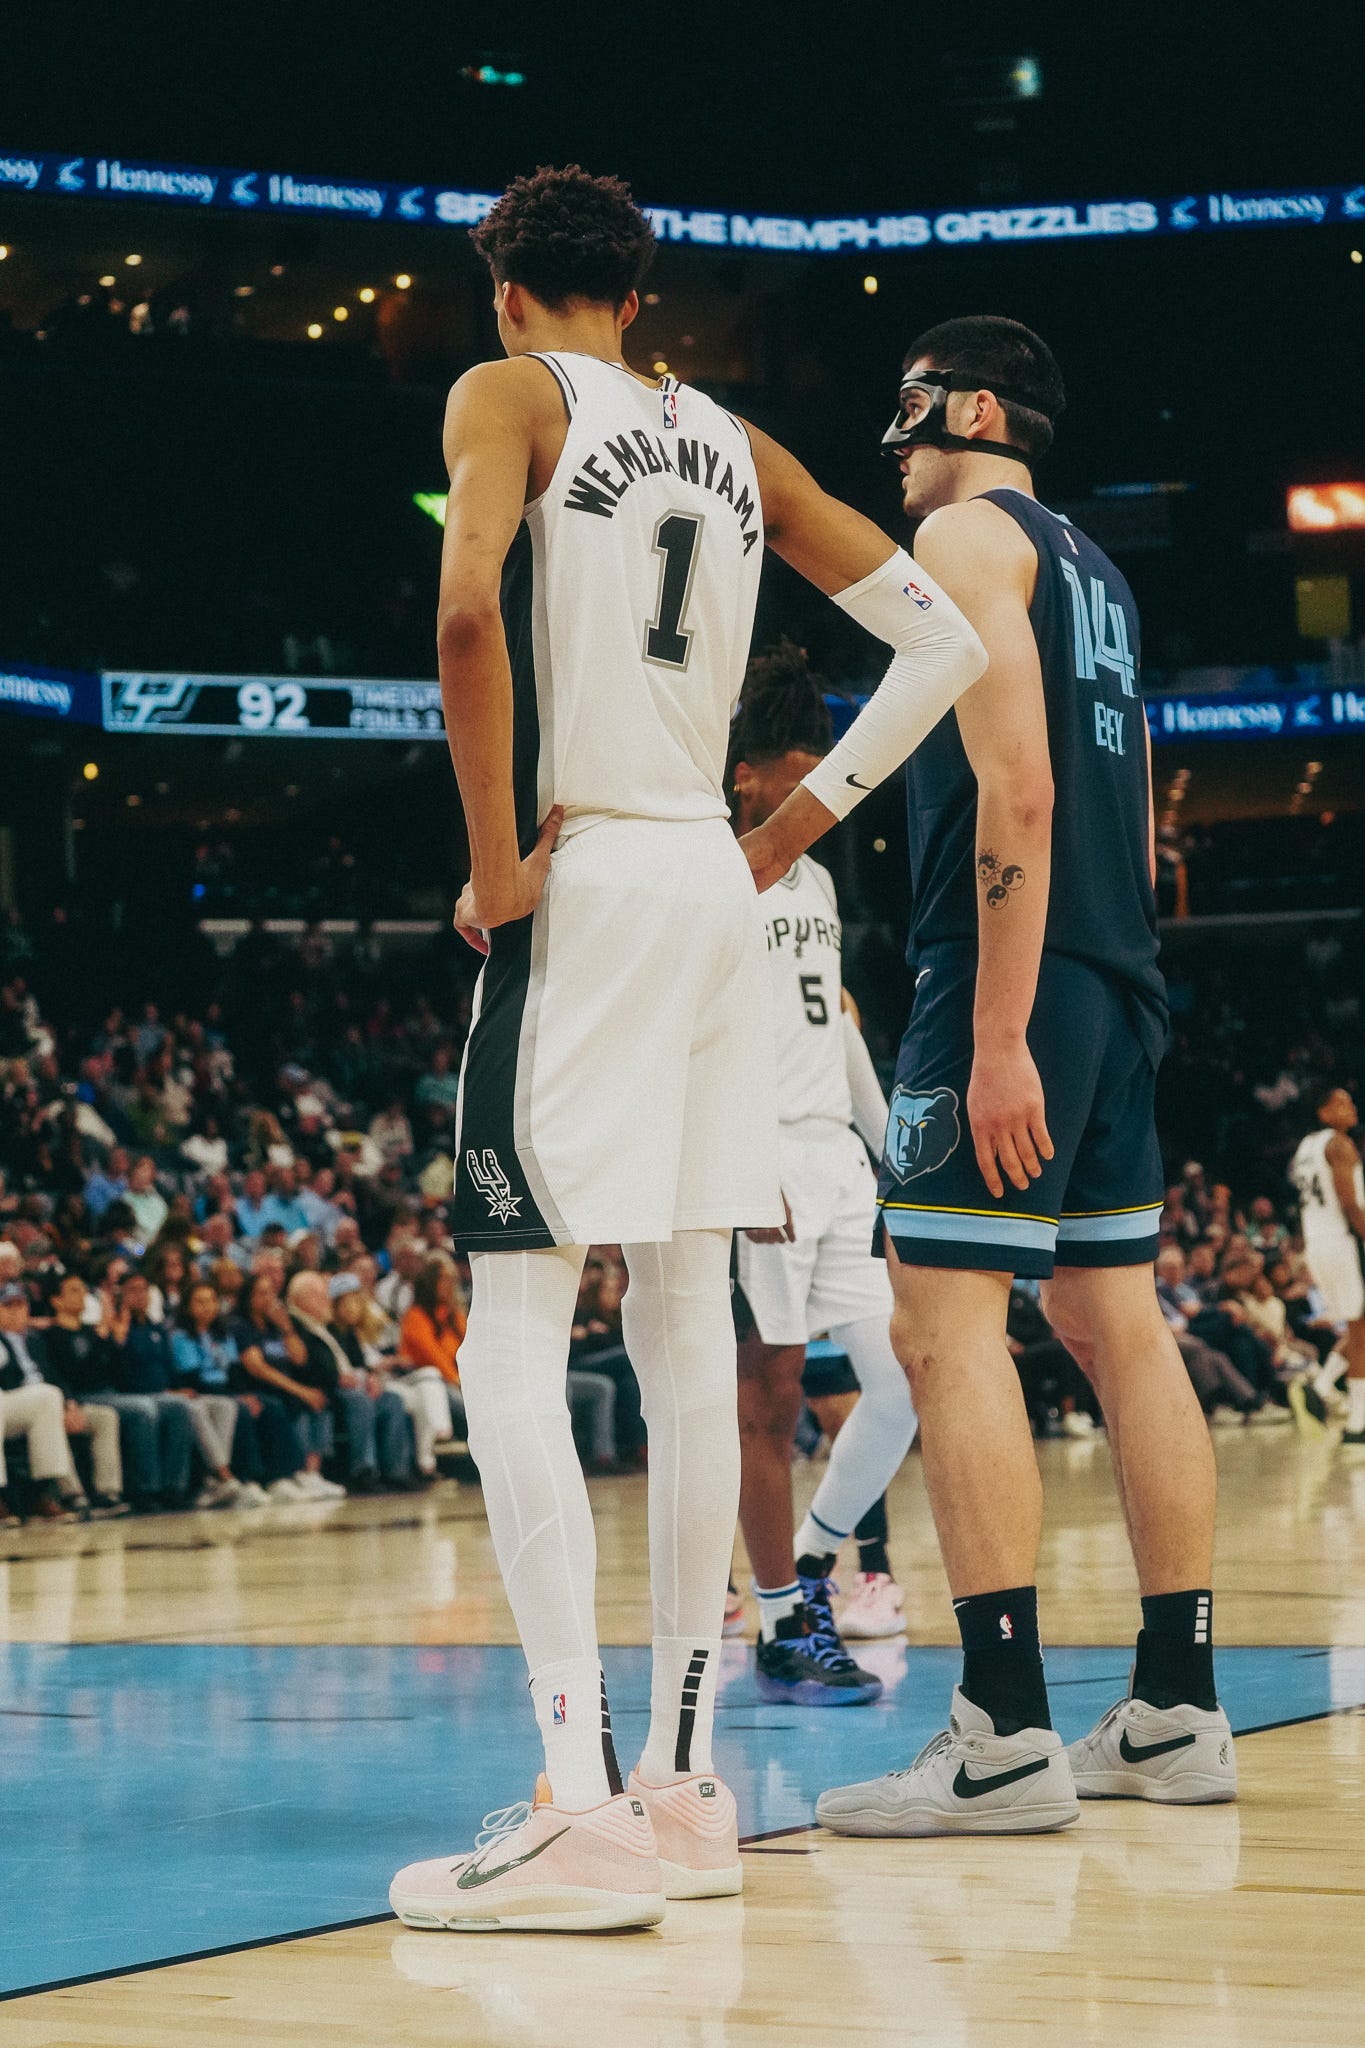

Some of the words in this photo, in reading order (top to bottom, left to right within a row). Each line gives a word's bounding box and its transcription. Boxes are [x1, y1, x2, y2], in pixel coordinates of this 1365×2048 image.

[96, 159, 218, 203] Hennessy
[269, 174, 387, 218] Hennessy
[434, 191, 502, 225] SP
[642, 207, 725, 244] THE
[730, 214, 932, 251] MEMPHIS
[935, 202, 1159, 242] GRIZZLIES
[1208, 194, 1329, 224] Hennessy
[564, 429, 758, 557] WEMBANYAMA
[641, 508, 705, 672] 1
[1060, 556, 1138, 698] 14
[238, 682, 310, 730] 92
[1095, 702, 1125, 756] BEY
[1162, 701, 1287, 733] Hennessy
[799, 974, 828, 1026] 5
